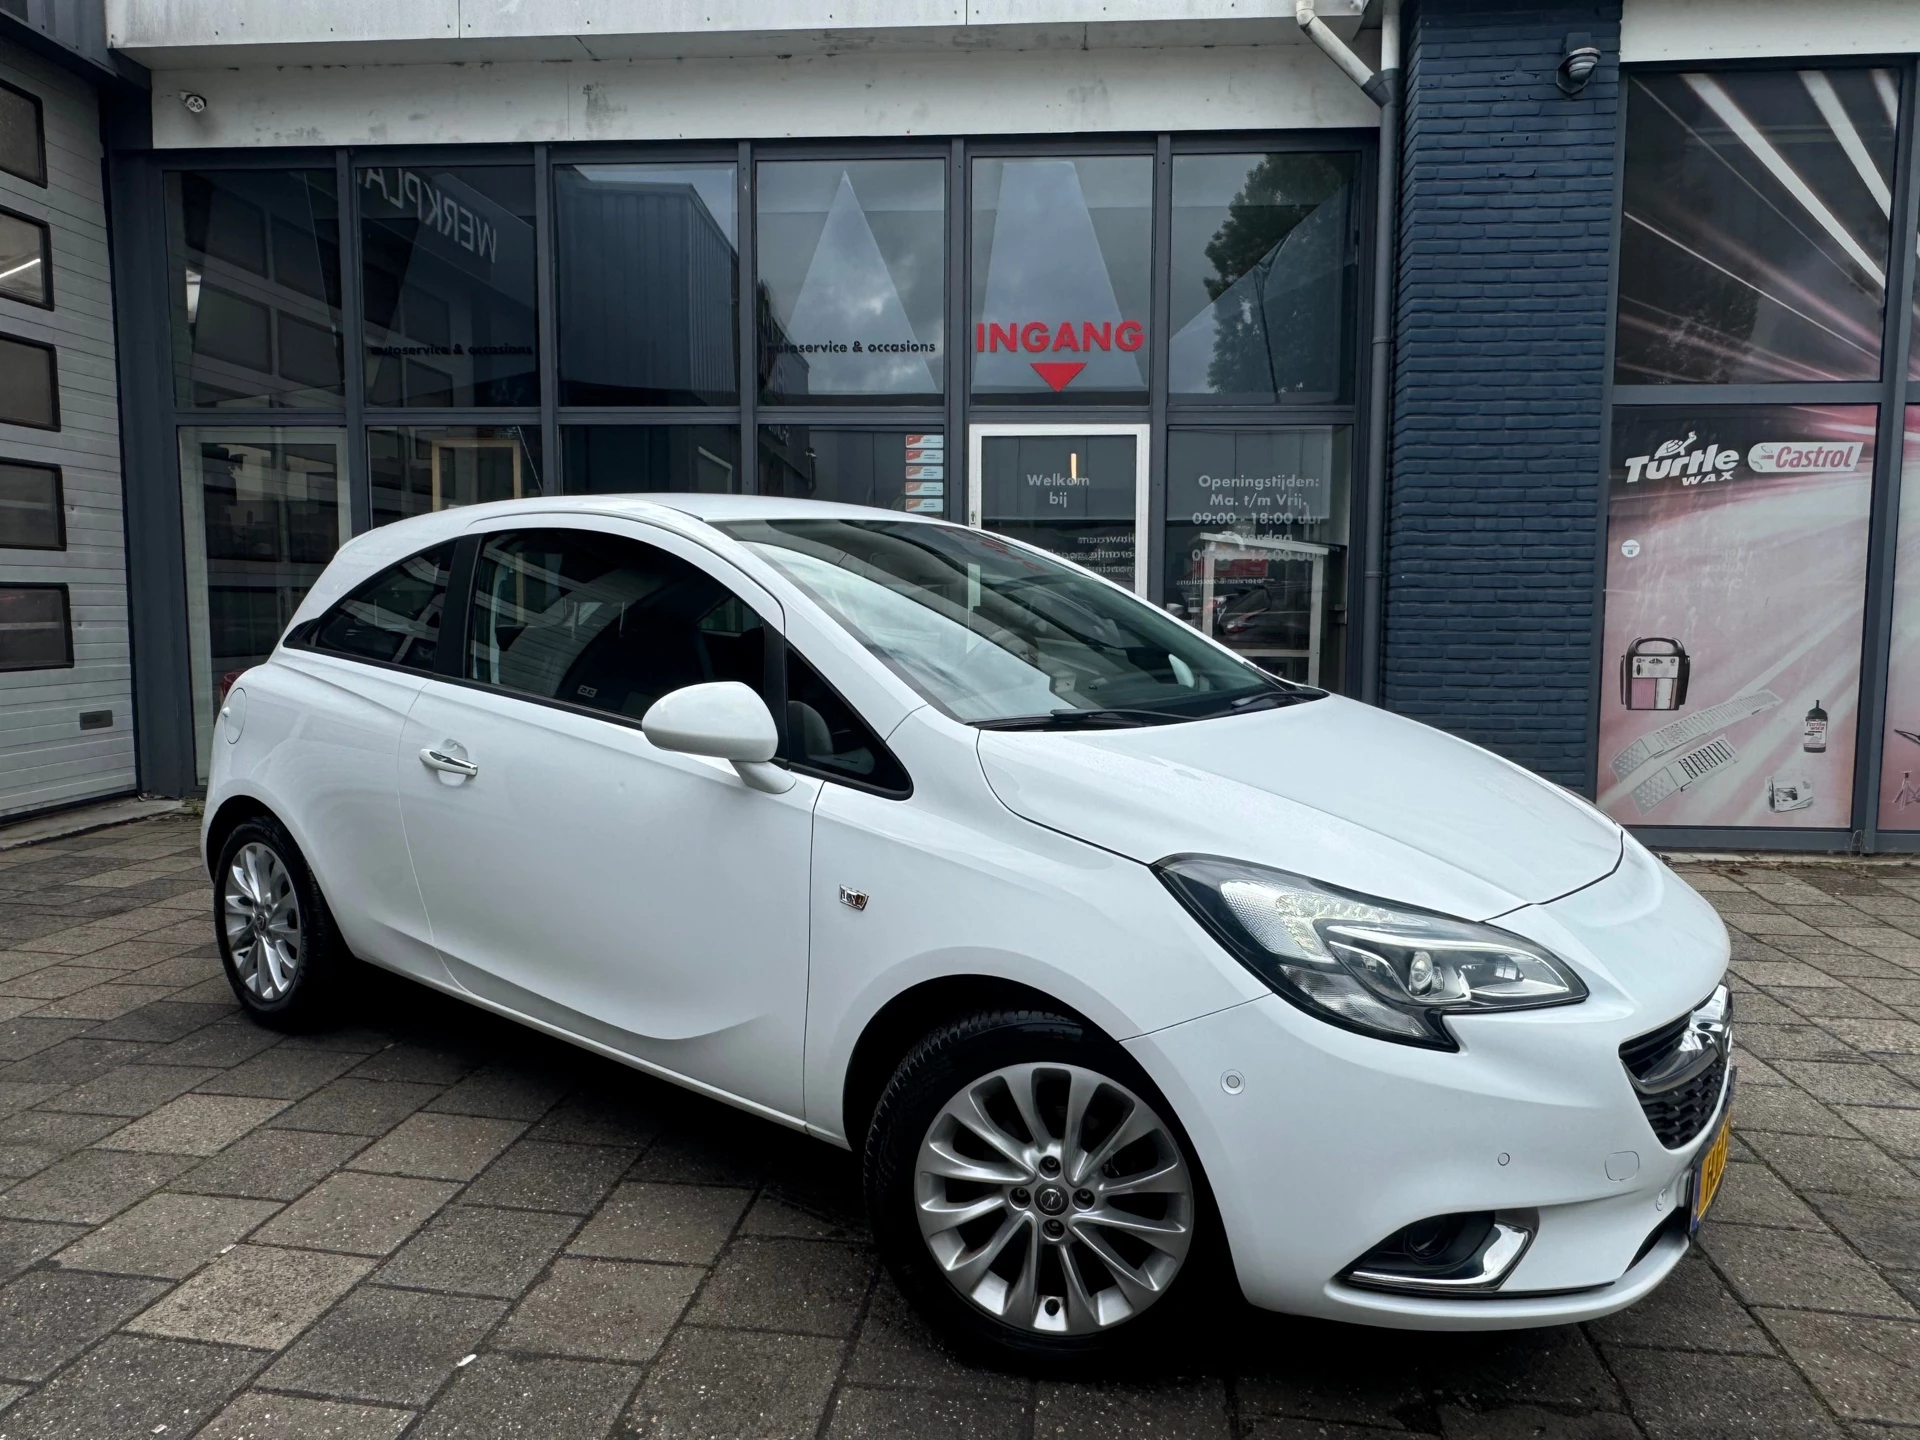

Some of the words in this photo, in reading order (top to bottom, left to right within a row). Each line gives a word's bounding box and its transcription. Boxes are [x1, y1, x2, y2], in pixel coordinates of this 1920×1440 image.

[976, 320, 1145, 353] INGANG
[852, 340, 863, 353] &
[868, 340, 936, 353] occasions
[1624, 443, 1740, 483] Turtle
[1775, 446, 1854, 468] Castrol
[1027, 473, 1090, 486] Welkom
[1198, 475, 1319, 490] Openingstijden:
[1049, 492, 1067, 508] bij
[1210, 494, 1239, 506] Ma.
[1244, 493, 1271, 508] t/m
[1276, 494, 1307, 508] Vrij.
[1192, 513, 1236, 525] 09:00
[1251, 513, 1293, 525] 18:00
